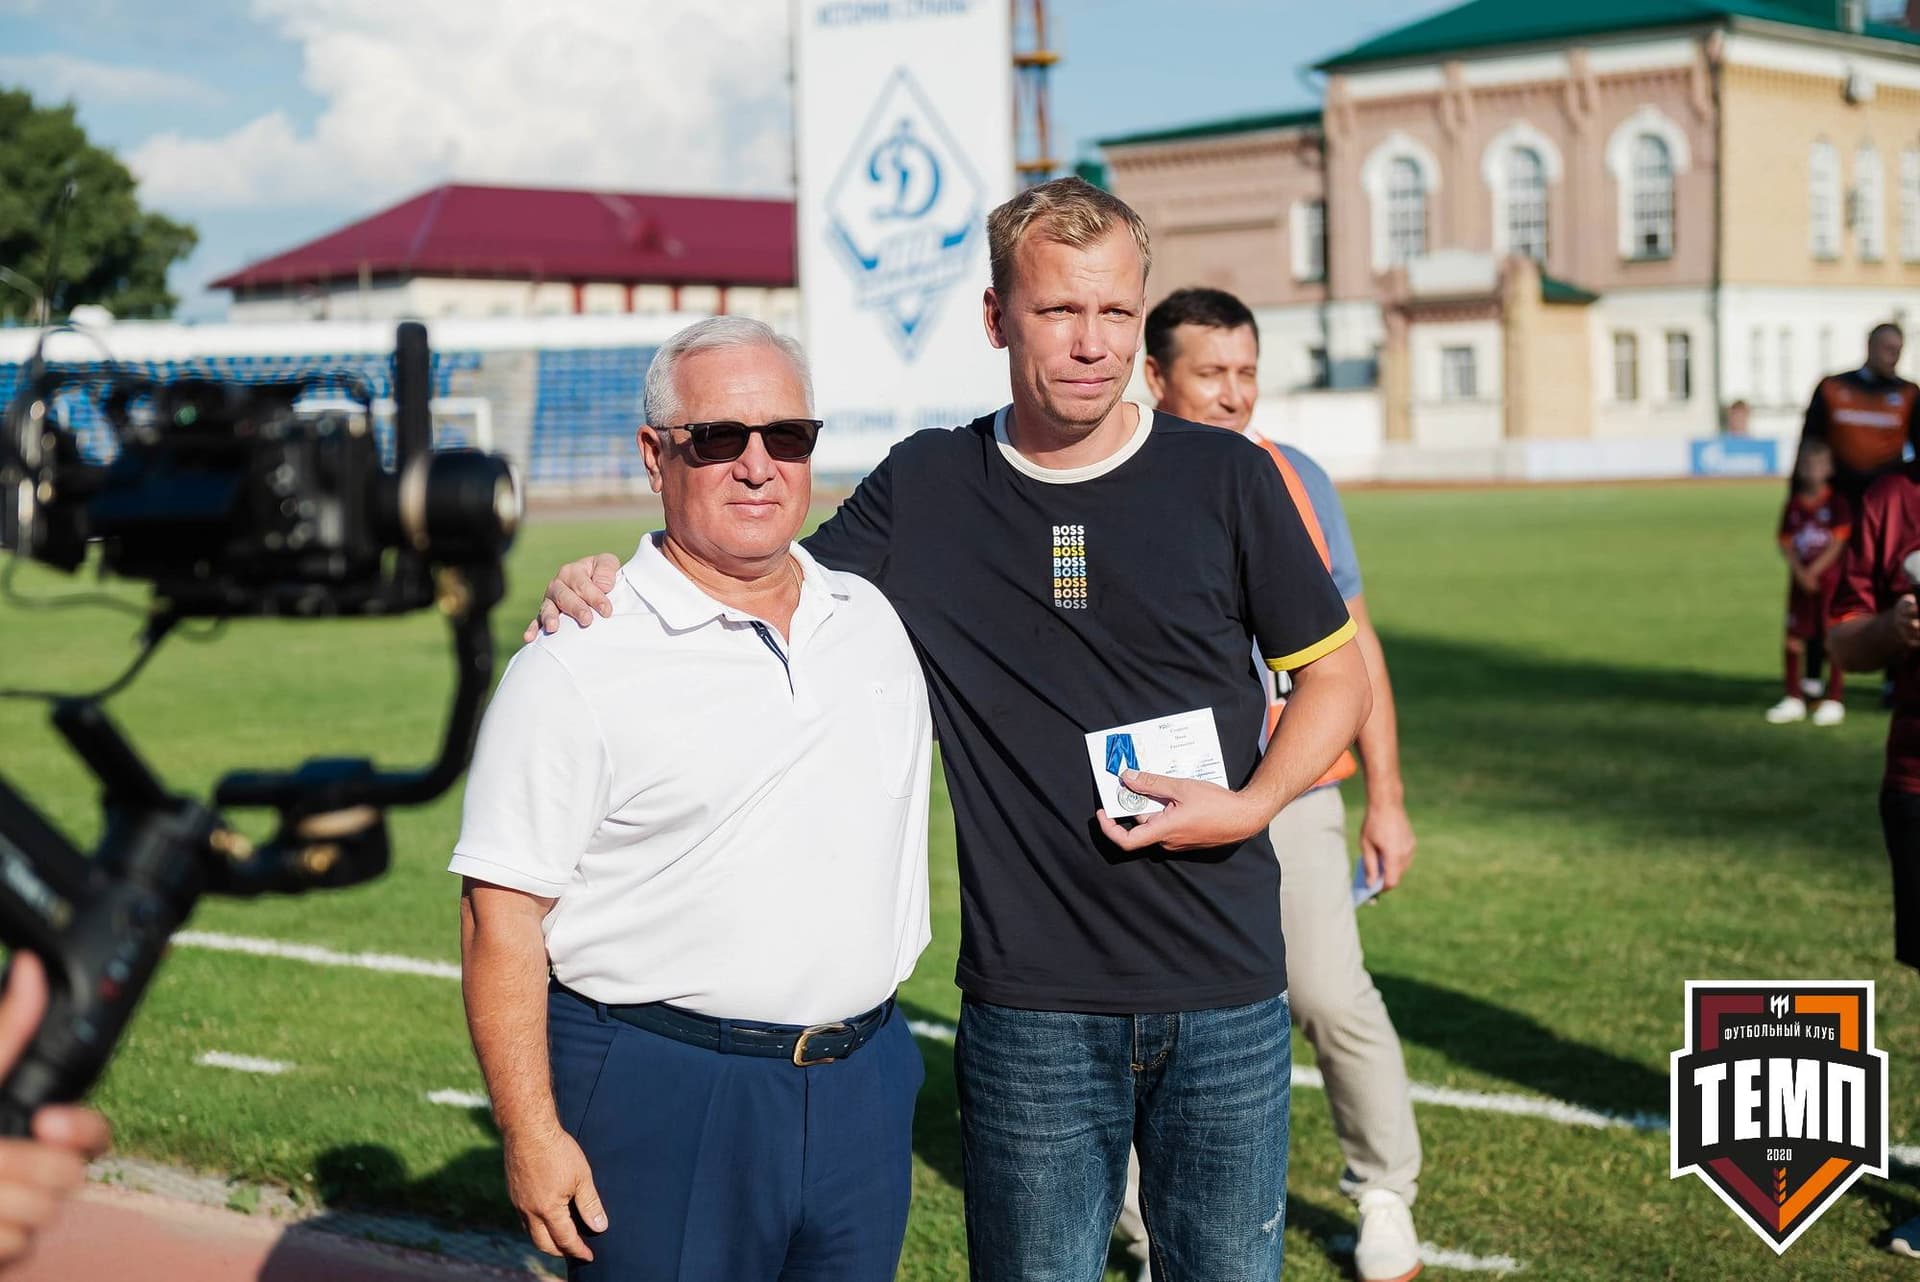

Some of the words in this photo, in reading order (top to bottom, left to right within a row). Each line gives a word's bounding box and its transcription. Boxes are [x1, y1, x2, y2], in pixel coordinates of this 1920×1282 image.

[1052, 525, 1085, 536] BOSS
[1053, 536, 1085, 546] BOSS
[1053, 546, 1086, 557] BOSS
[1053, 557, 1087, 567] BOSS
[1053, 567, 1087, 577] BOSS
[1054, 577, 1088, 588] BOSS
[1054, 588, 1088, 599] BOSS
[1055, 599, 1088, 609] BOSS
